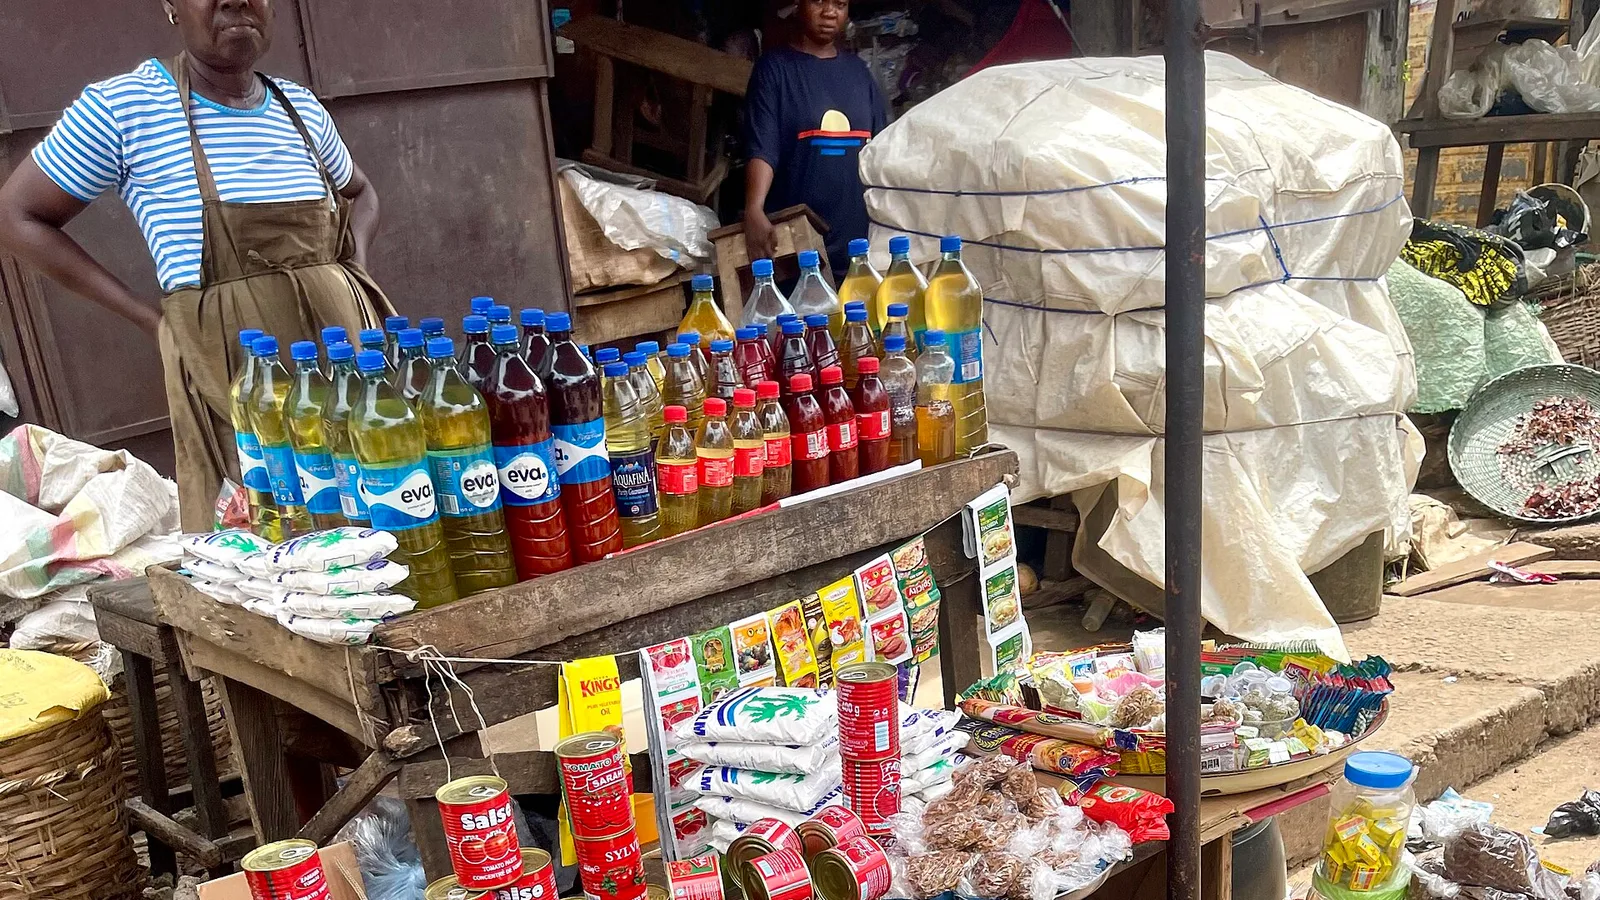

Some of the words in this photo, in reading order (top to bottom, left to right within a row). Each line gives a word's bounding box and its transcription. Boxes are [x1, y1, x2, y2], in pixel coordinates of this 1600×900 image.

[613, 466, 652, 488] AQUAFINA
[580, 677, 620, 698] KING'S
[563, 757, 611, 772] TOMATO
[592, 769, 624, 789] SARAH
[482, 862, 505, 872] TOMATO
